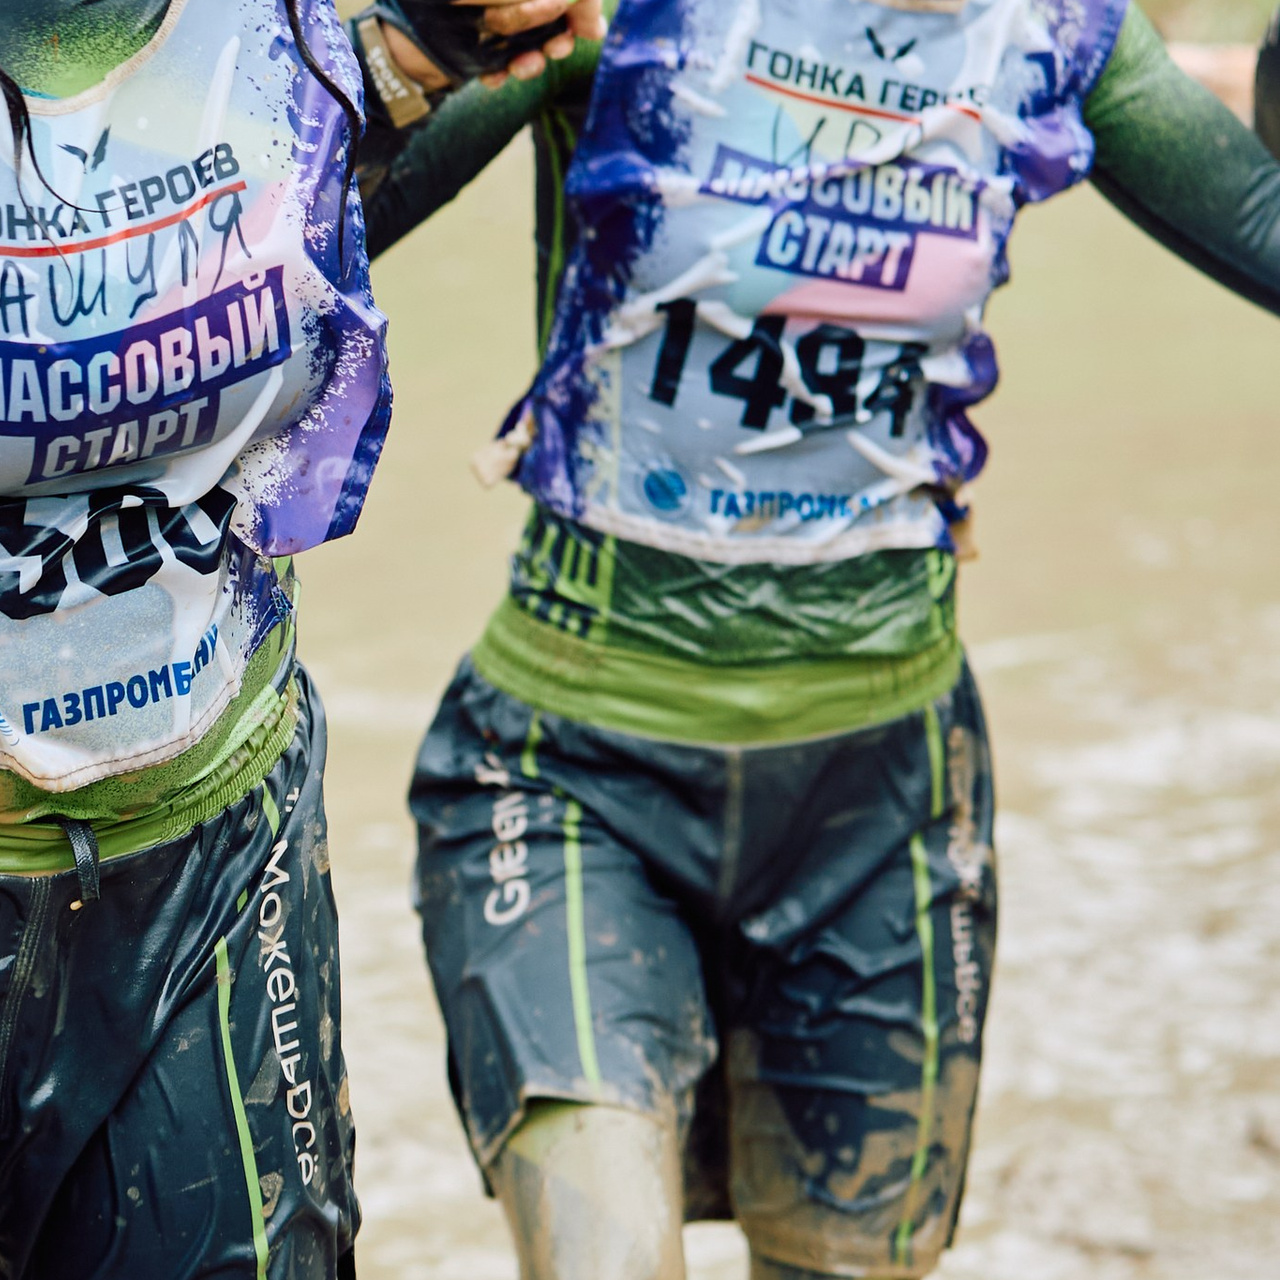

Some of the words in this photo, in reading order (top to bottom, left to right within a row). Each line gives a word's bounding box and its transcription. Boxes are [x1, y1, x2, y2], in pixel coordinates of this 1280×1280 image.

[747, 41, 866, 100] ГОНКА
[879, 79, 984, 112] ГЕР
[95, 143, 240, 228] ГЕРОЕВ
[766, 209, 911, 286] СТАРТ
[42, 395, 210, 480] СТАРТ
[22, 623, 218, 735] ГАЗПРОМБН
